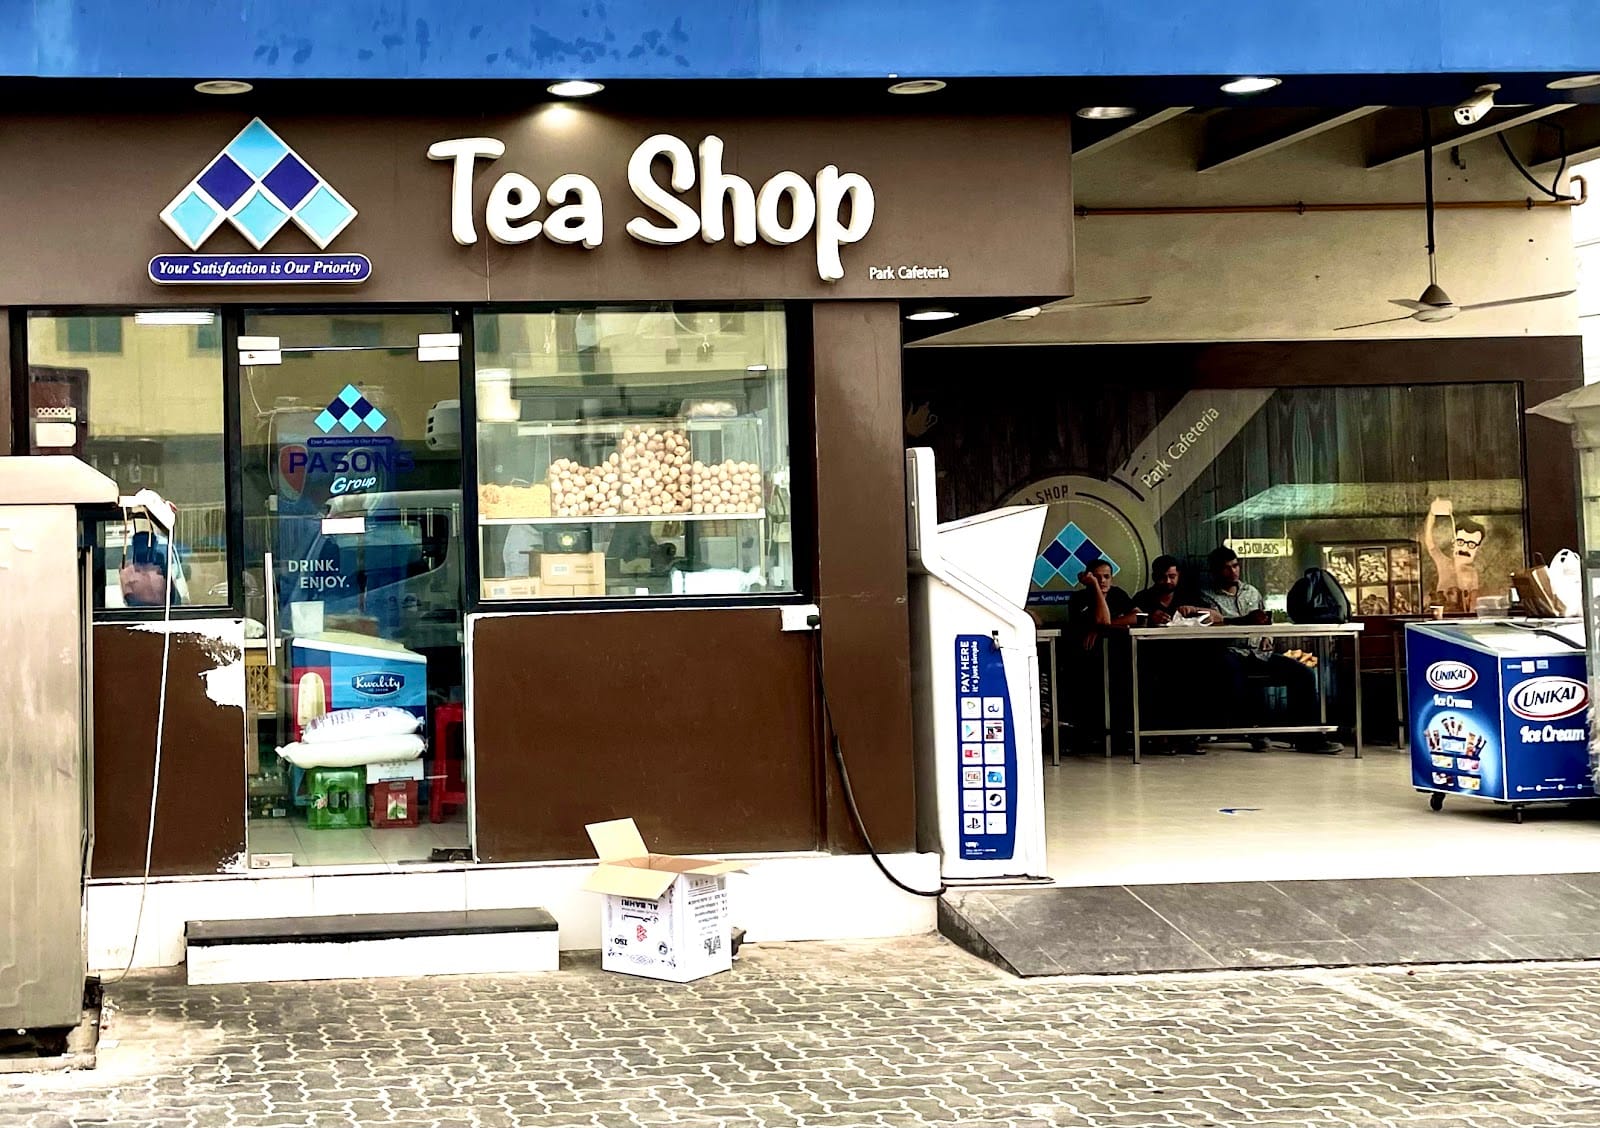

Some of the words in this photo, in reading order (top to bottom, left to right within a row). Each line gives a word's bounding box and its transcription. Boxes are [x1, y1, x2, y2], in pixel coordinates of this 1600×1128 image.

[427, 137, 604, 250] Tea
[626, 133, 876, 282] Shop
[159, 261, 189, 275] Your
[192, 261, 267, 277] Satisfaction
[270, 261, 281, 274] is
[284, 261, 310, 275] Our
[313, 260, 362, 276] Priority
[869, 266, 896, 280] Park
[898, 265, 950, 279] Cafeteria
[1141, 459, 1172, 489] Park
[1168, 407, 1220, 460] Cafeteria
[288, 451, 416, 474] PASONS
[329, 476, 377, 493] Group
[1036, 484, 1069, 504] SHOP
[288, 559, 339, 573] DRINK.
[300, 575, 350, 591] ENJOY.
[960, 641, 970, 670] HERE
[355, 675, 401, 691] Kwality
[960, 672, 970, 693] PAY
[1435, 669, 1467, 682] UNIKAI
[1523, 686, 1577, 707] UNIKAI
[1520, 725, 1541, 743] Ice
[1542, 725, 1585, 743] Cream
